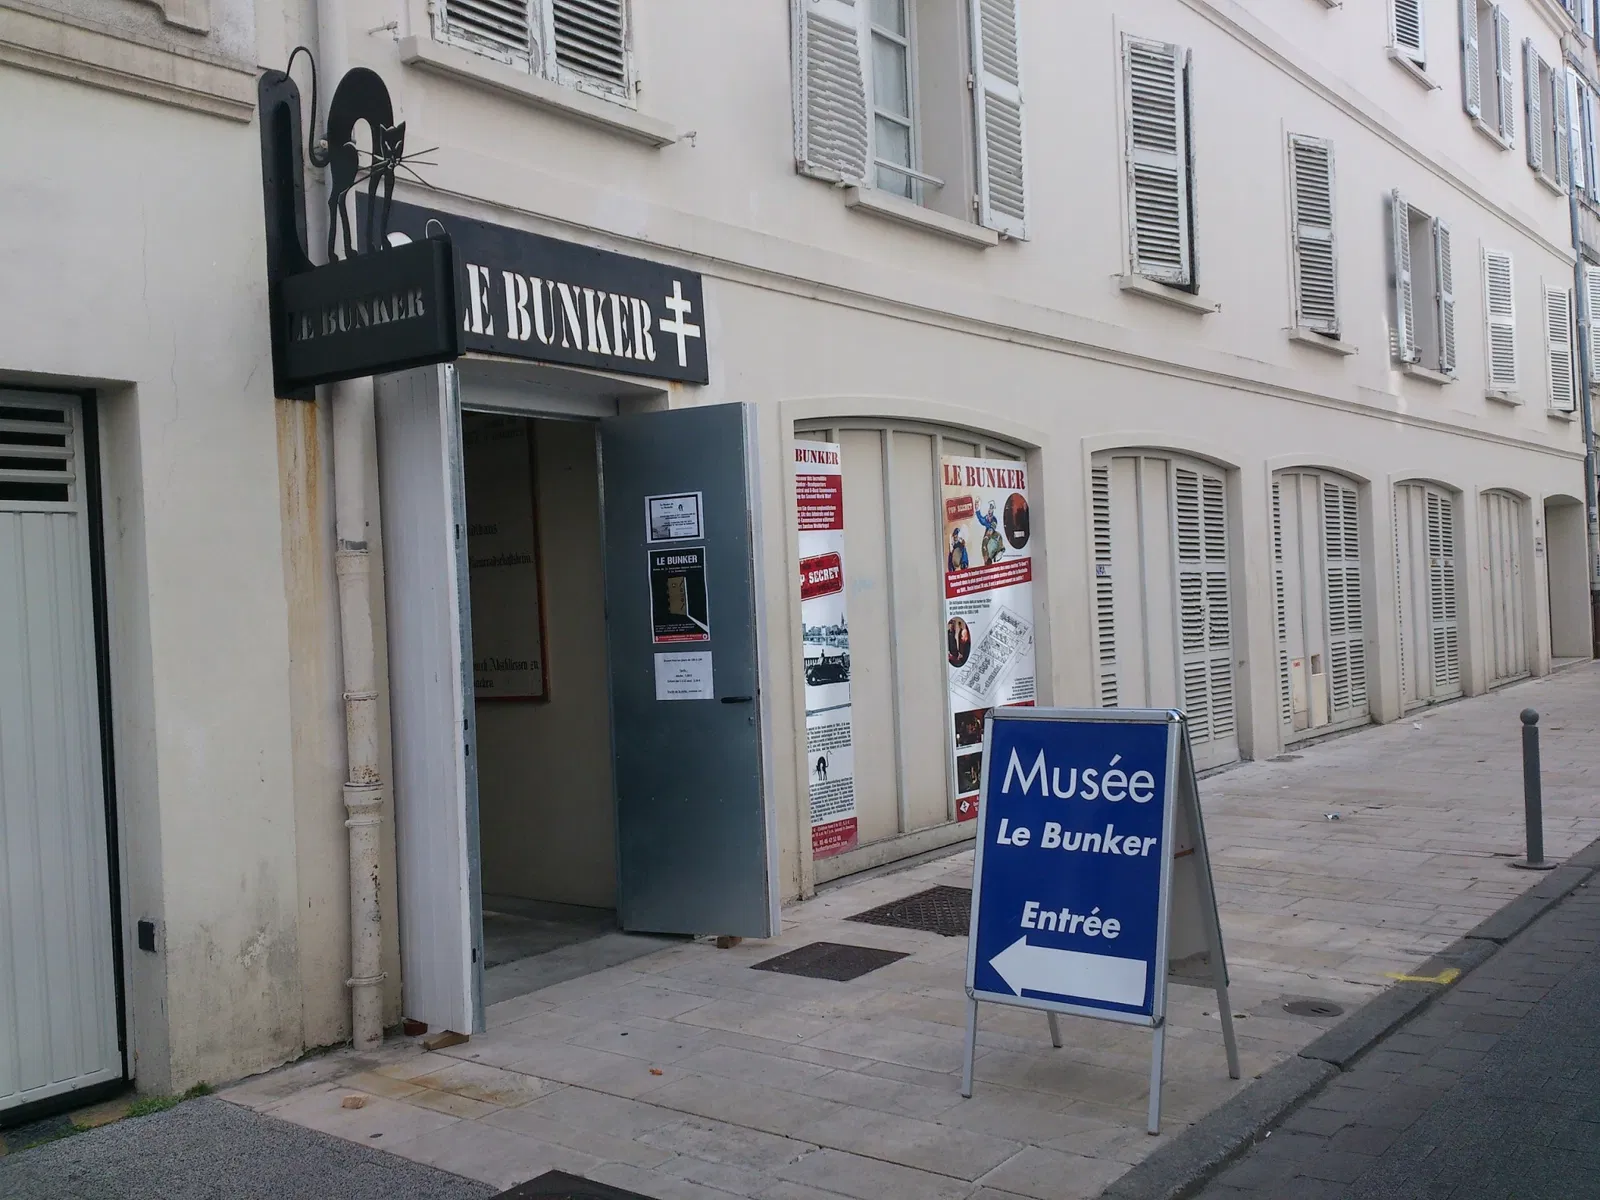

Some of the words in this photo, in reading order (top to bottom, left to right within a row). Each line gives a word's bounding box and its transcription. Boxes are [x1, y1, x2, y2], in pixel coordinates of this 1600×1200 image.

[321, 287, 426, 336] BUNKER
[464, 263, 495, 336] E
[502, 270, 657, 362] BUNKER
[795, 448, 839, 465] BUNKER
[944, 464, 962, 486] LE
[965, 466, 1026, 490] BUNKER
[656, 557, 666, 566] LE
[667, 554, 698, 566] BUNKER
[808, 566, 839, 584] SECRET
[1002, 746, 1155, 804] Musée
[996, 818, 1031, 847] Le
[1040, 821, 1157, 858] Bunker
[1020, 900, 1121, 939] Entrée
